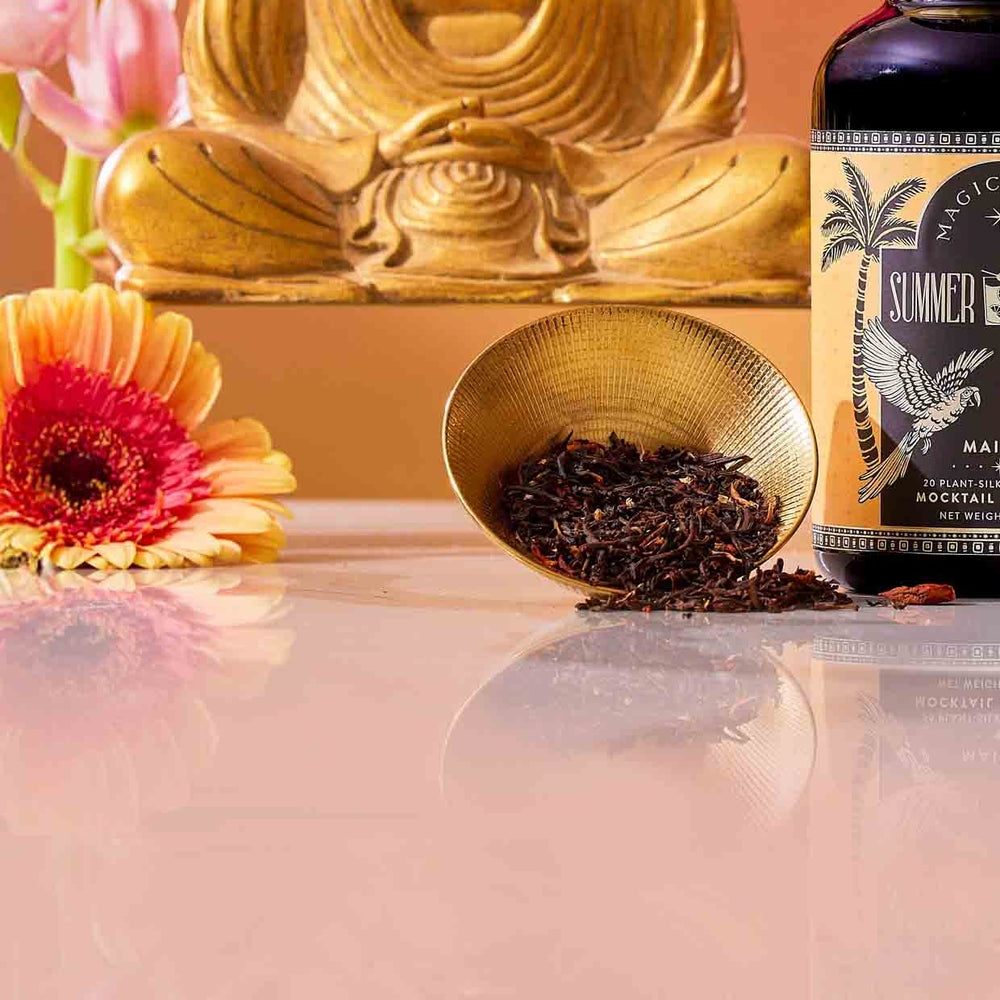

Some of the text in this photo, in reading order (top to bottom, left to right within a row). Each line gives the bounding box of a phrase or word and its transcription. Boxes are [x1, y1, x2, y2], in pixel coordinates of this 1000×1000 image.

[936, 176, 1000, 241] MAGIC
[889, 271, 975, 323] SUMMER
[963, 440, 998, 453] MAI
[923, 478, 936, 487] 20
[916, 492, 995, 504] MOCKTAIL
[939, 511, 961, 520] NET
